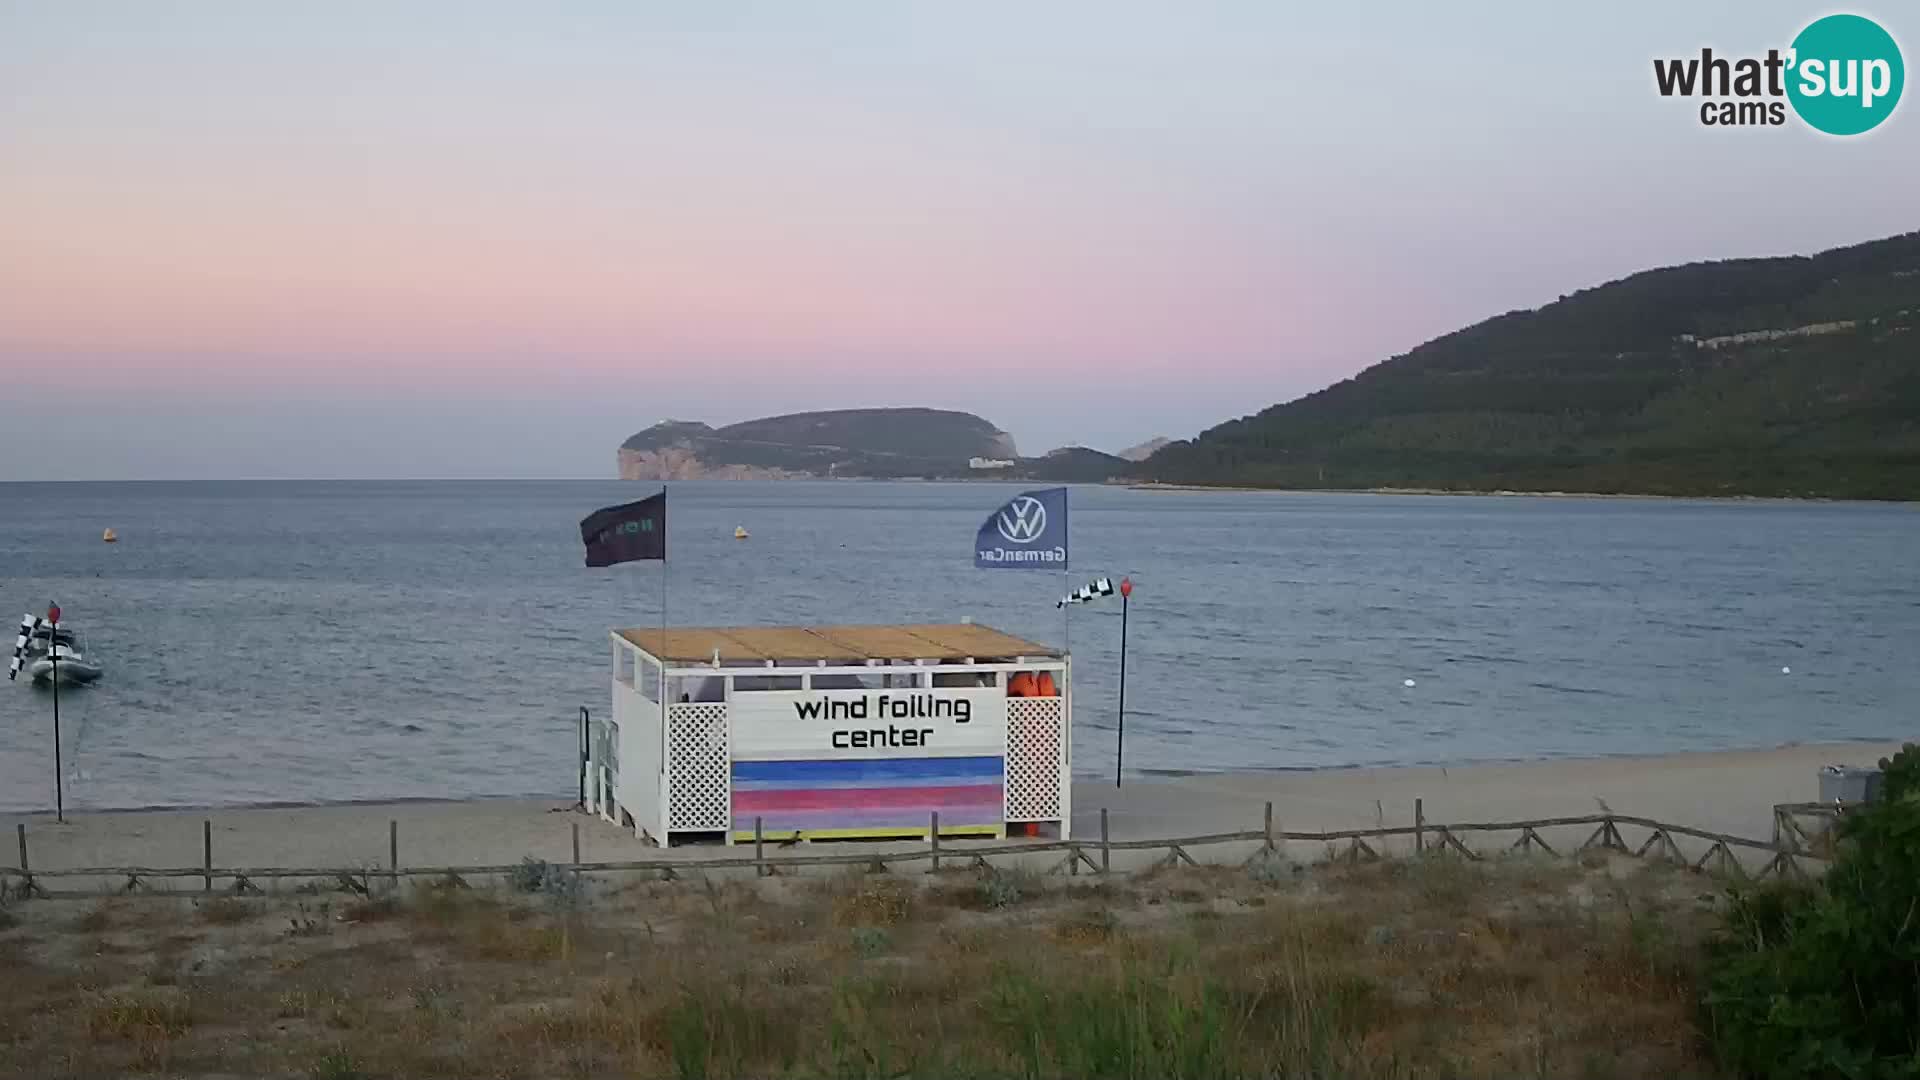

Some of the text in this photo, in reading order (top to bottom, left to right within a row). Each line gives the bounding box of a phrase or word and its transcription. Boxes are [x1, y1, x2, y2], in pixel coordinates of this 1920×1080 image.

[794, 694, 972, 723] wind foiling
[832, 724, 934, 748] center
